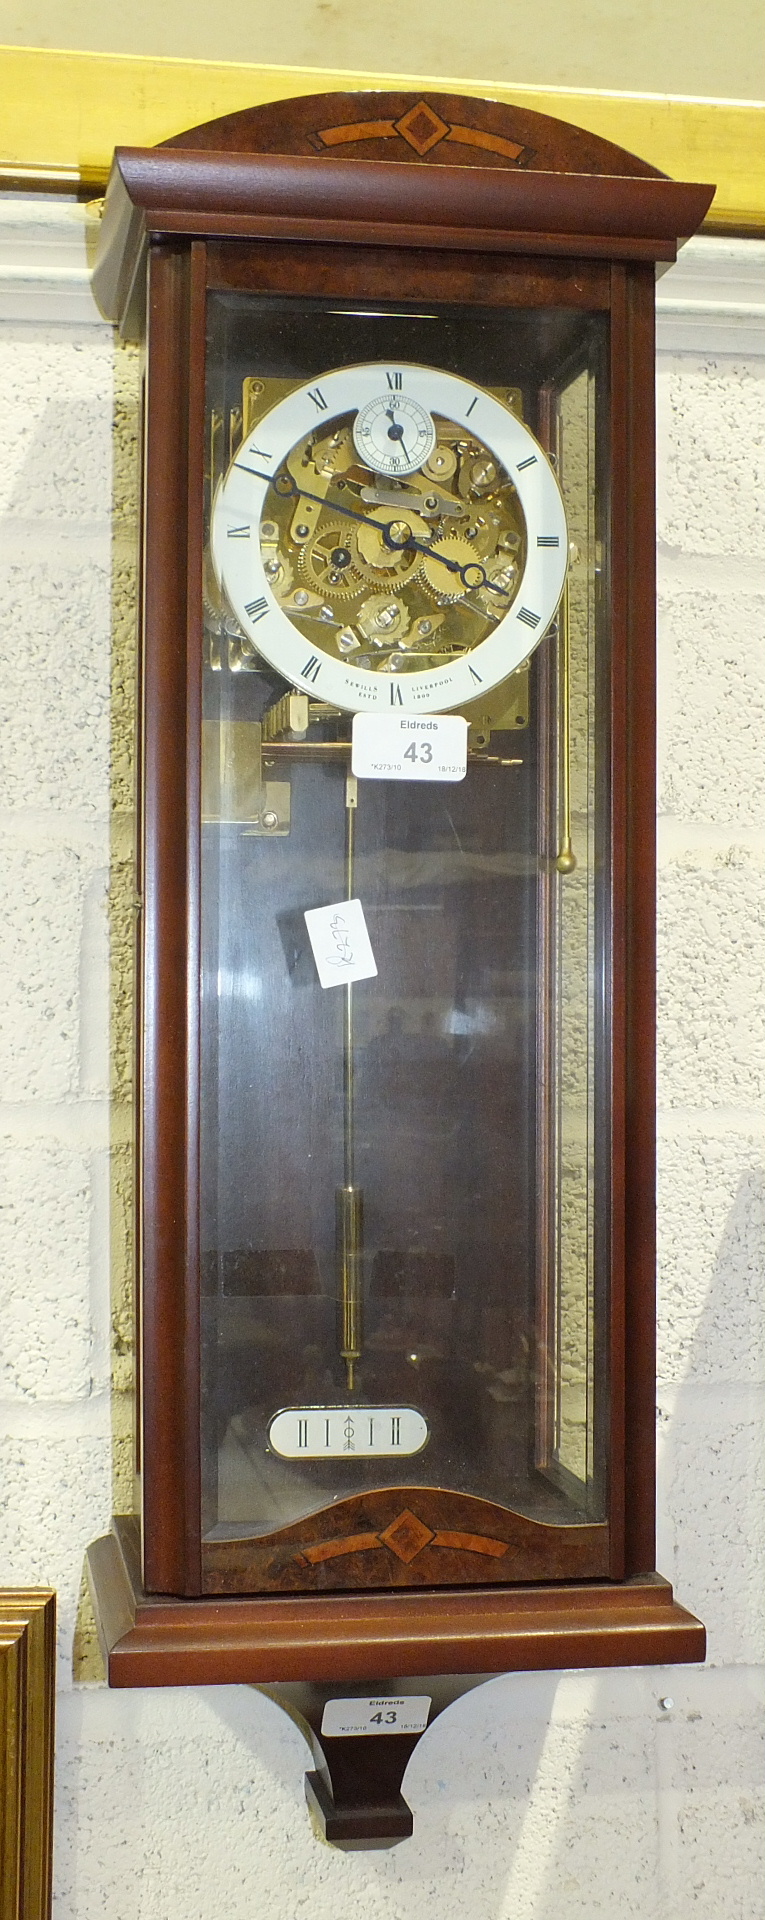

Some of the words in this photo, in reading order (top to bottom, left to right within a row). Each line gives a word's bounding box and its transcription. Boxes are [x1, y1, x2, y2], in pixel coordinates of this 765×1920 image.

[389, 401, 400, 410] 60
[389, 457, 400, 466] 30
[345, 679, 378, 692] SEWILLS
[411, 677, 453, 692] LIVERPOOL
[358, 692, 377, 701] ESTD
[400, 720, 438, 730] Eldreds
[403, 742, 433, 764] 43
[370, 1711, 398, 1725] 43
